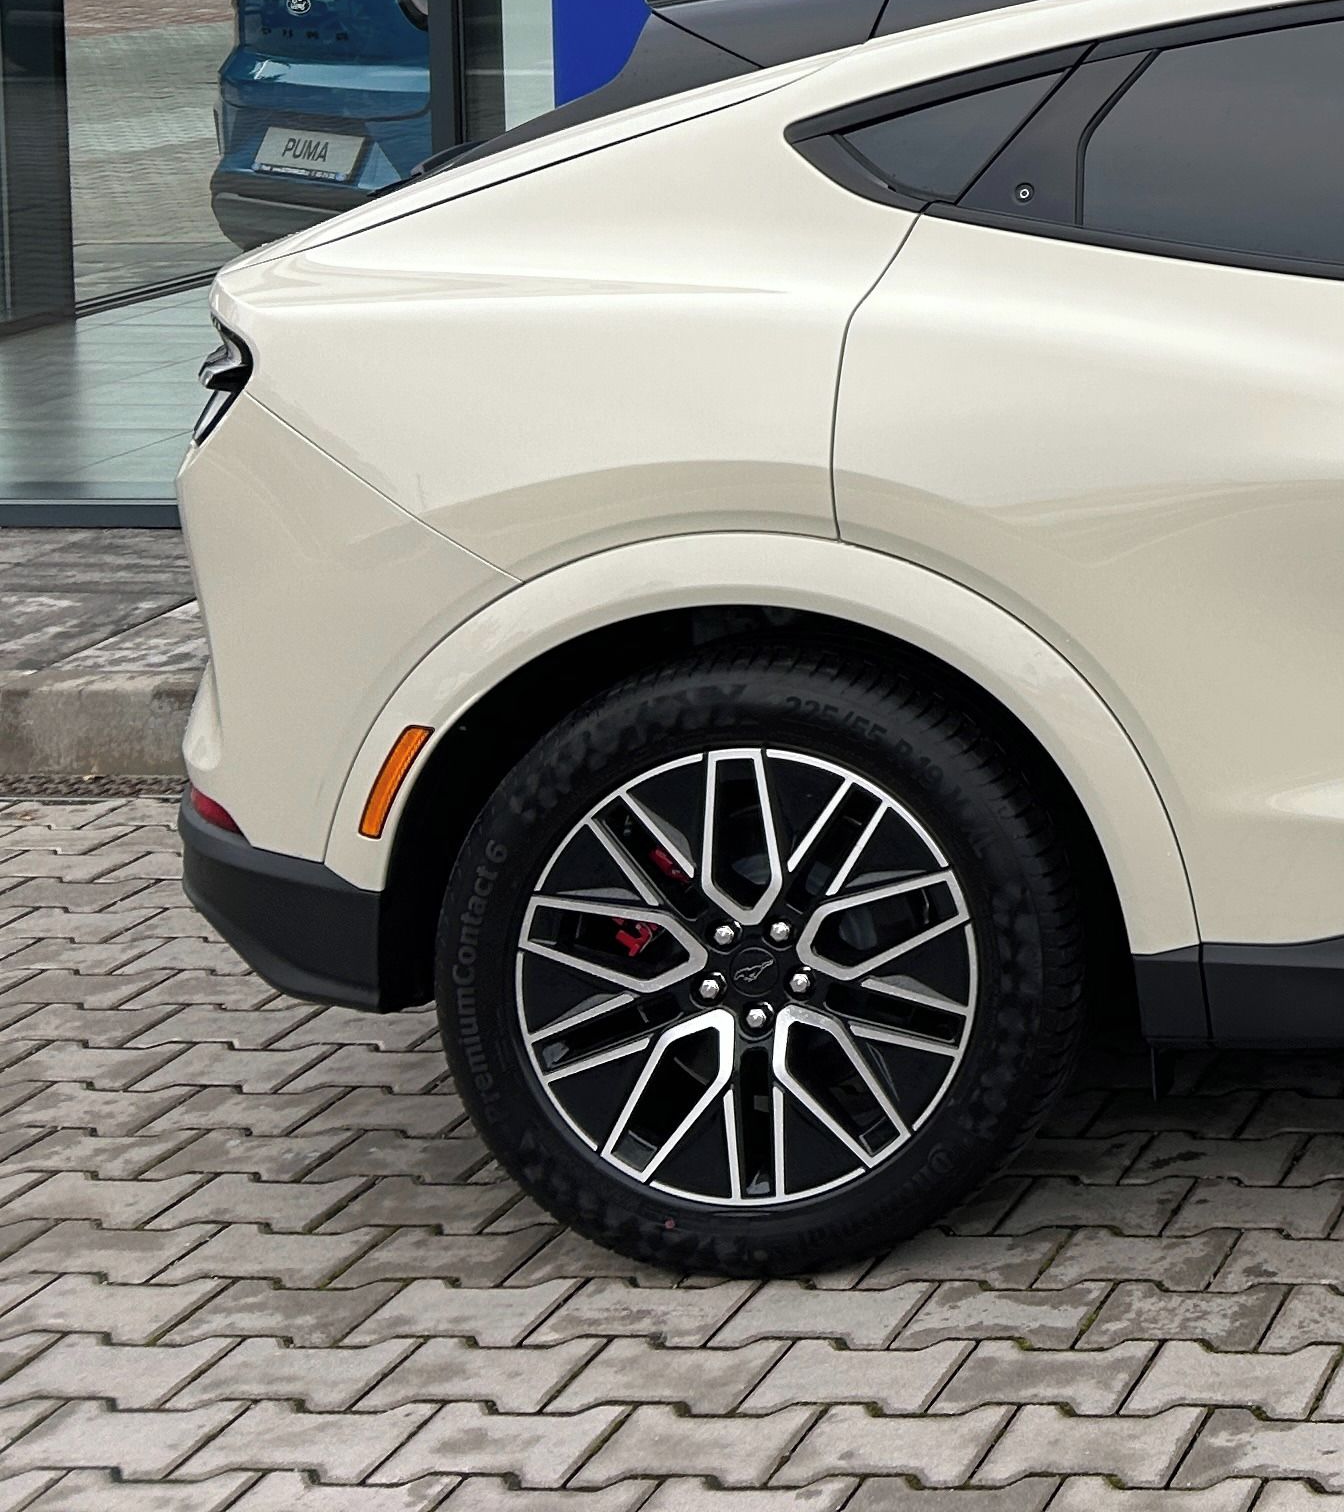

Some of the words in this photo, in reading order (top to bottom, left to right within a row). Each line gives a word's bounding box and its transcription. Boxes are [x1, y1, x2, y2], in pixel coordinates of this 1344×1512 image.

[281, 137, 330, 162] PUMA
[783, 695, 889, 748] 225/55
[451, 863, 503, 1128] PremiumContact
[484, 838, 510, 865] 6
